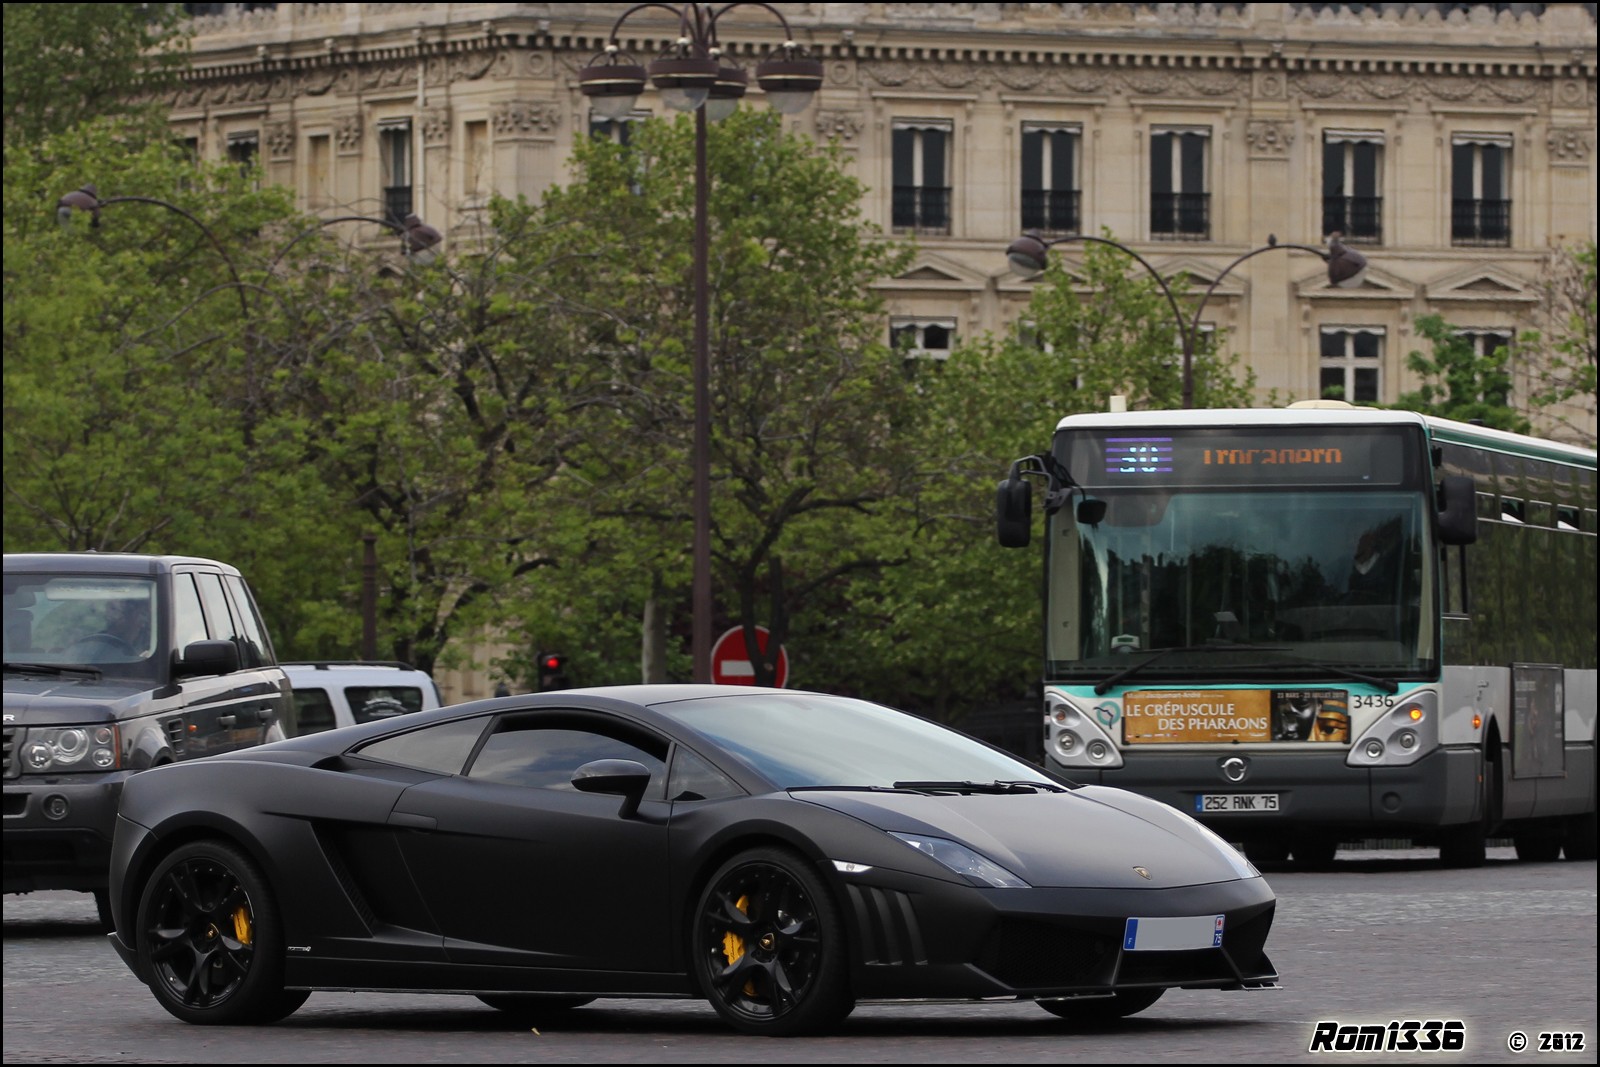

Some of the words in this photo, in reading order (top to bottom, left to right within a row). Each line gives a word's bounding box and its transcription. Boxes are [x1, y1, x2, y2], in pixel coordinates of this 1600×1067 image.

[1126, 704, 1141, 717] LE
[1144, 701, 1235, 717] CRÉPUSCULE
[1353, 694, 1394, 709] 3436
[1158, 718, 1185, 730] DES
[1188, 717, 1268, 730] PHARAONS
[1204, 796, 1228, 810] 252
[1233, 796, 1256, 809] RNK
[1261, 795, 1276, 809] 75
